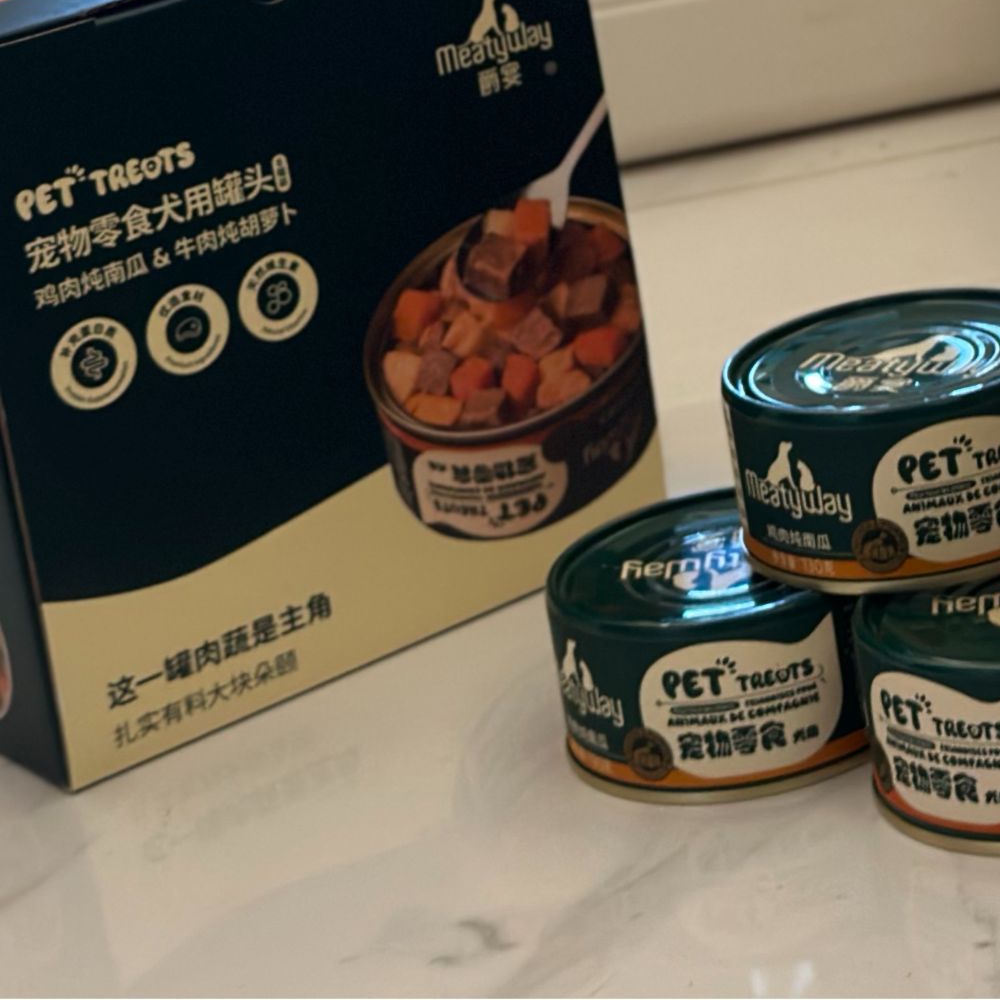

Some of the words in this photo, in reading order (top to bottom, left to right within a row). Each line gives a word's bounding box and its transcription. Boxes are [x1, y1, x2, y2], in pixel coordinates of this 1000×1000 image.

[14, 175, 77, 222] PET
[23, 162, 275, 275] 宠物零食犬用罐头
[33, 251, 150, 311] 鸡肉炖南瓜
[152, 246, 172, 270] &
[173, 200, 298, 261] 牛肉炖胡萝卜
[896, 445, 964, 485] PET
[902, 494, 966, 515] ANIMAUX
[966, 488, 982, 502] DE
[106, 591, 333, 710] 这一罐肉蔬是主角
[112, 648, 299, 750] 扎实有料大块朵颐
[661, 666, 726, 700] PET
[666, 713, 727, 728] ANIMAUX
[729, 712, 746, 723] DE
[879, 688, 924, 731] PET
